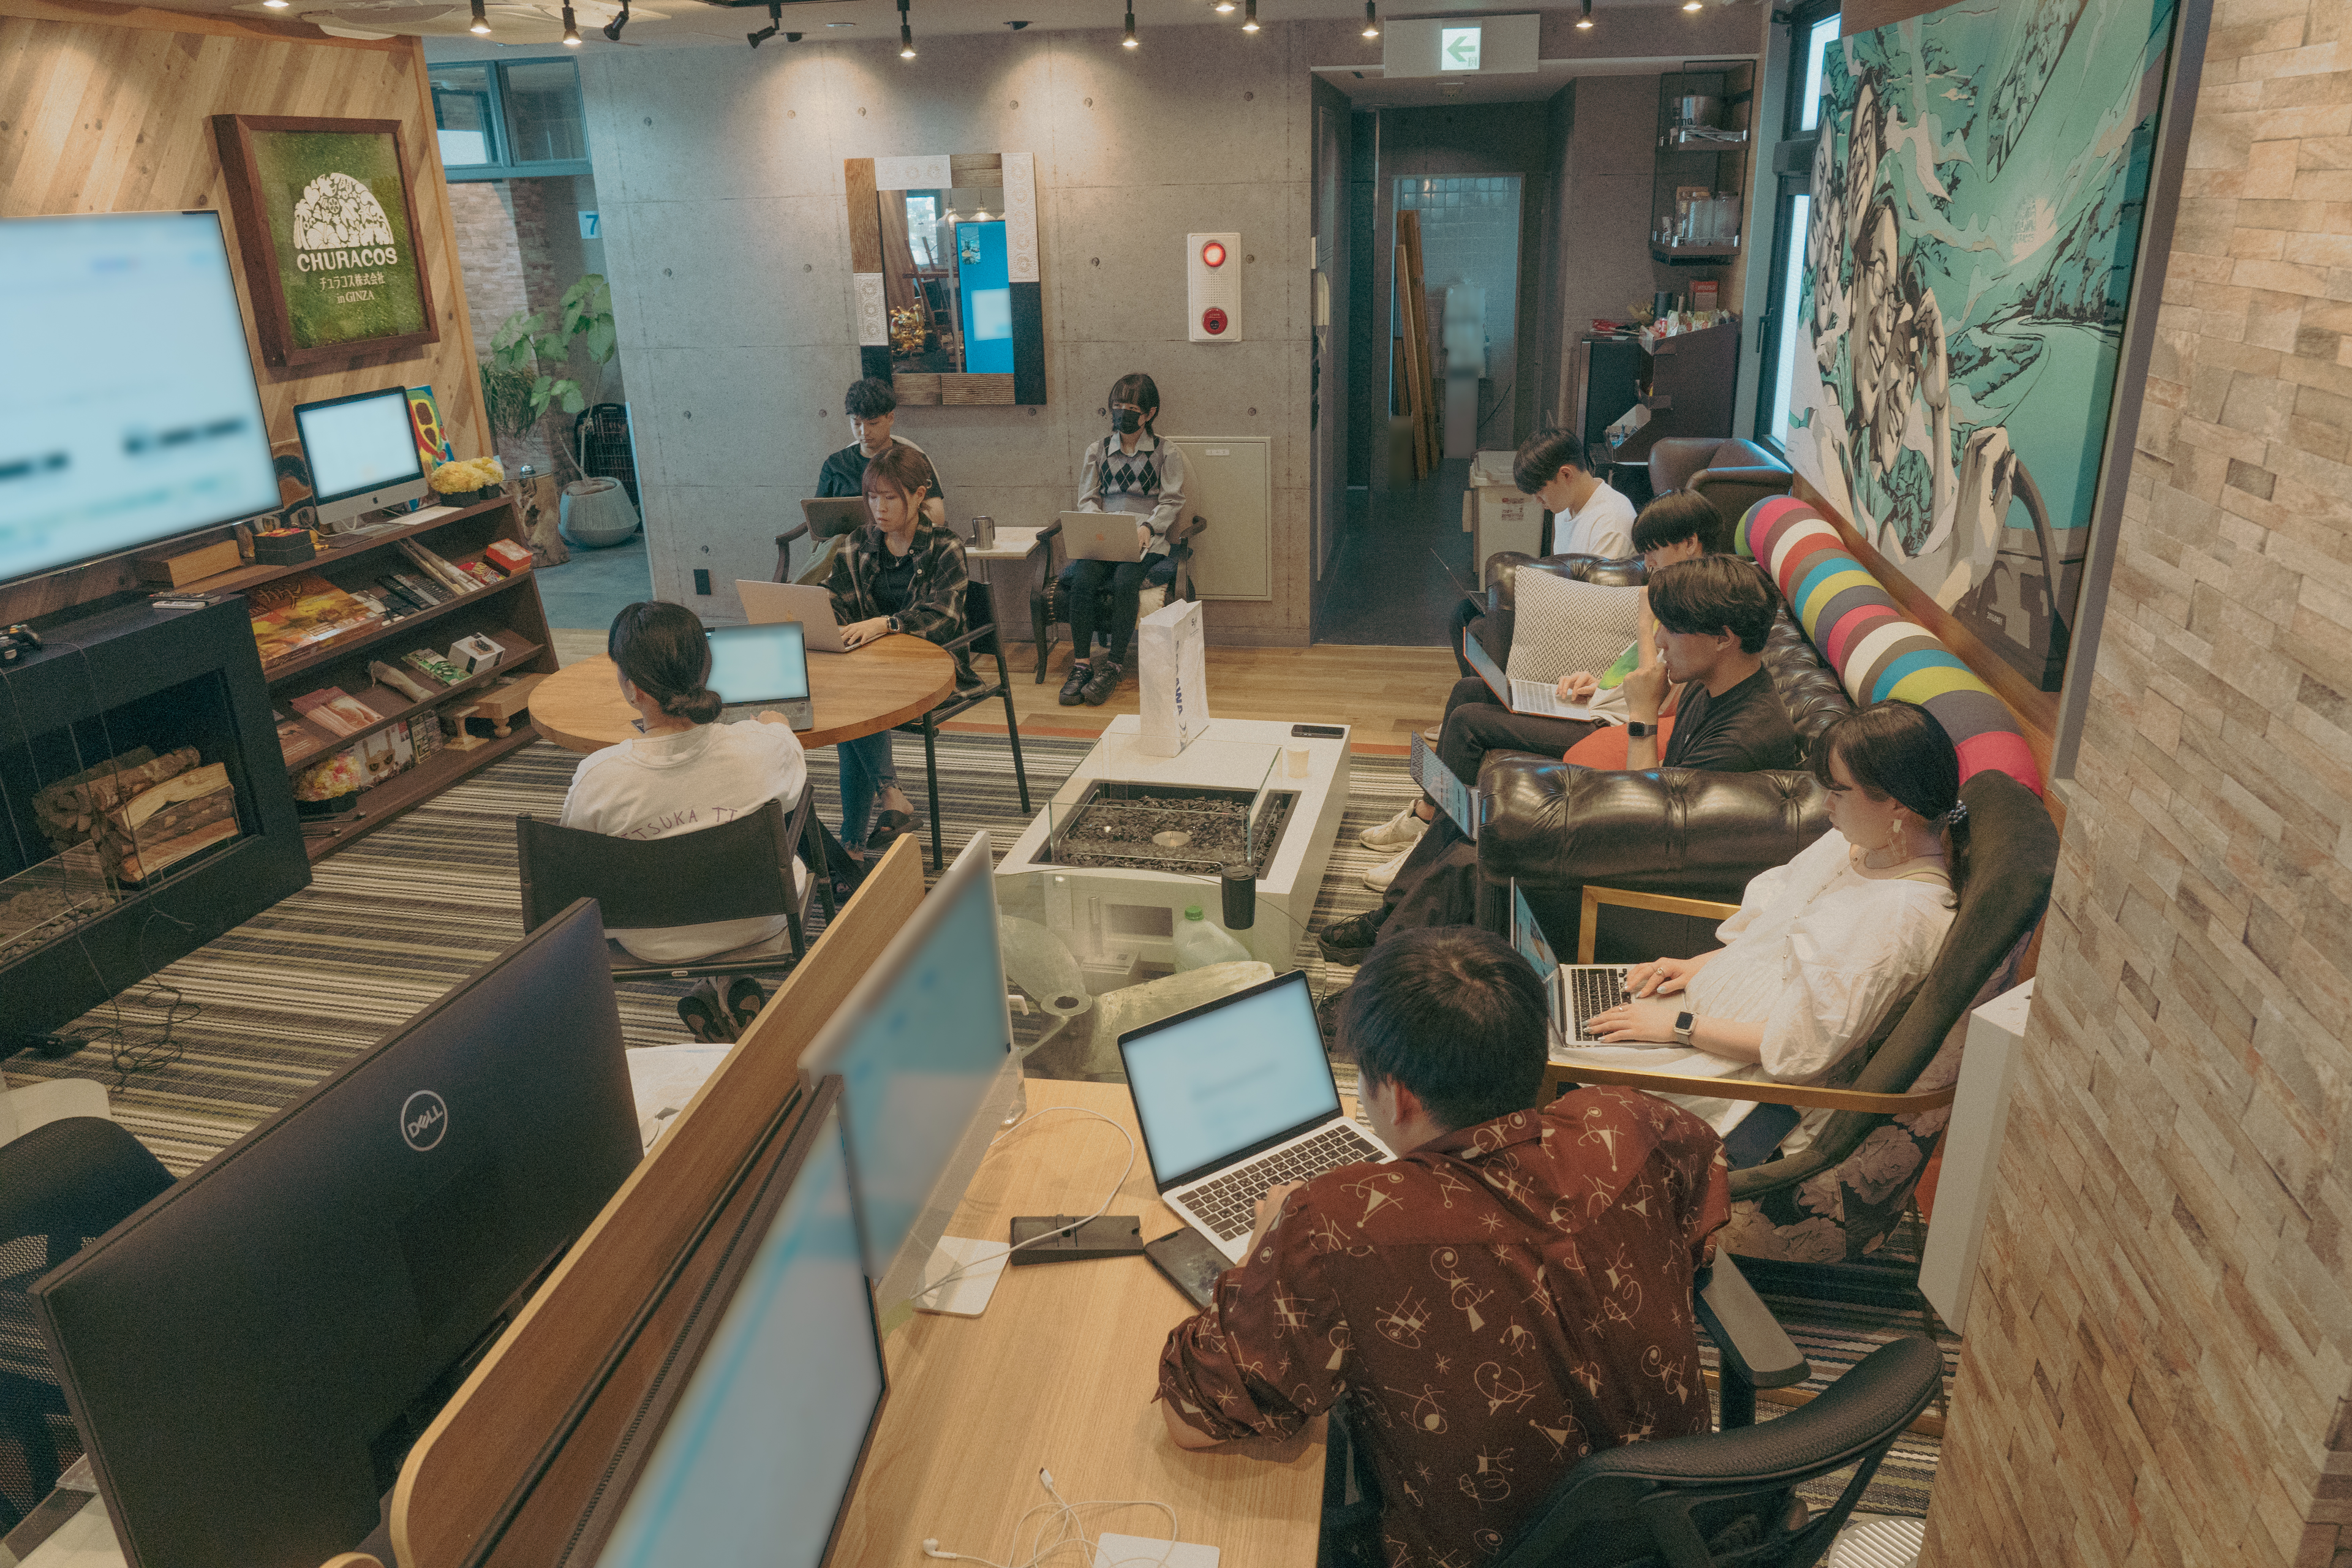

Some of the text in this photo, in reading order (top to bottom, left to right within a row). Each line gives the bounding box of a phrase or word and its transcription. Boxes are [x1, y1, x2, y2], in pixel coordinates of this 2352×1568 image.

[586, 214, 599, 235] 7
[297, 247, 398, 272] CHURACOS
[319, 271, 386, 292] チュラコス株式会社
[336, 290, 375, 304] in GINZA
[407, 1104, 443, 1139] DELL
